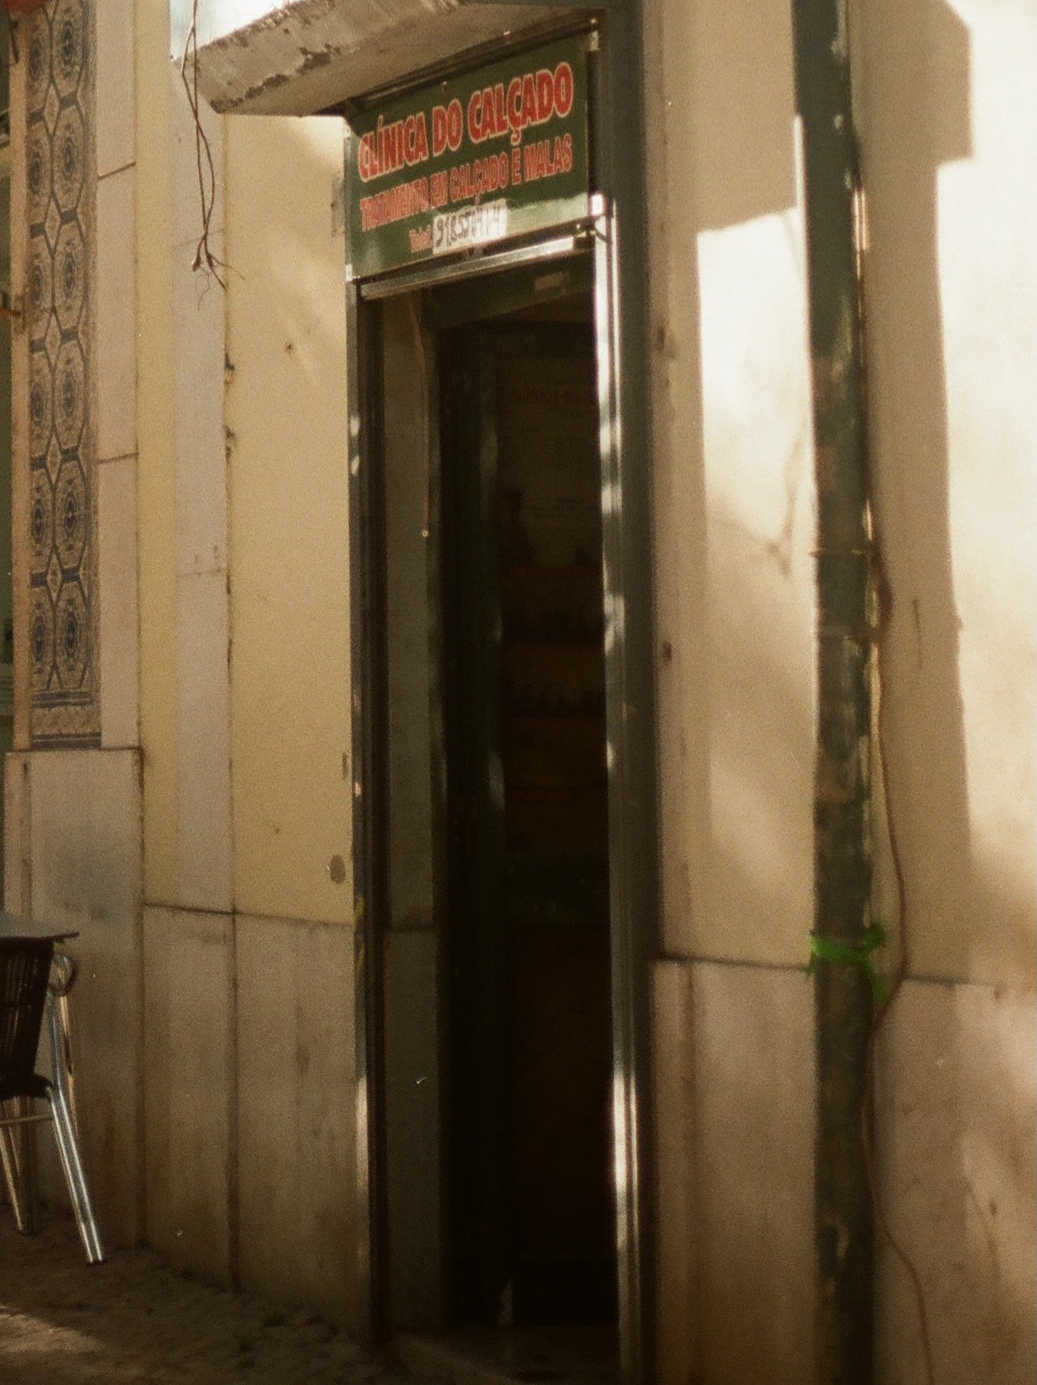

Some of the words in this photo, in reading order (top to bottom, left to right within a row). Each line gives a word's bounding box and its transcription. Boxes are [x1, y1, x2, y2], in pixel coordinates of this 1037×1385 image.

[358, 112, 429, 182] CLÍNICA
[432, 99, 464, 157] DO
[467, 62, 574, 145] CALÇADO
[431, 171, 448, 208] EM
[449, 151, 509, 205] CALÇADO
[511, 148, 521, 186] E
[524, 133, 573, 182] MALAS
